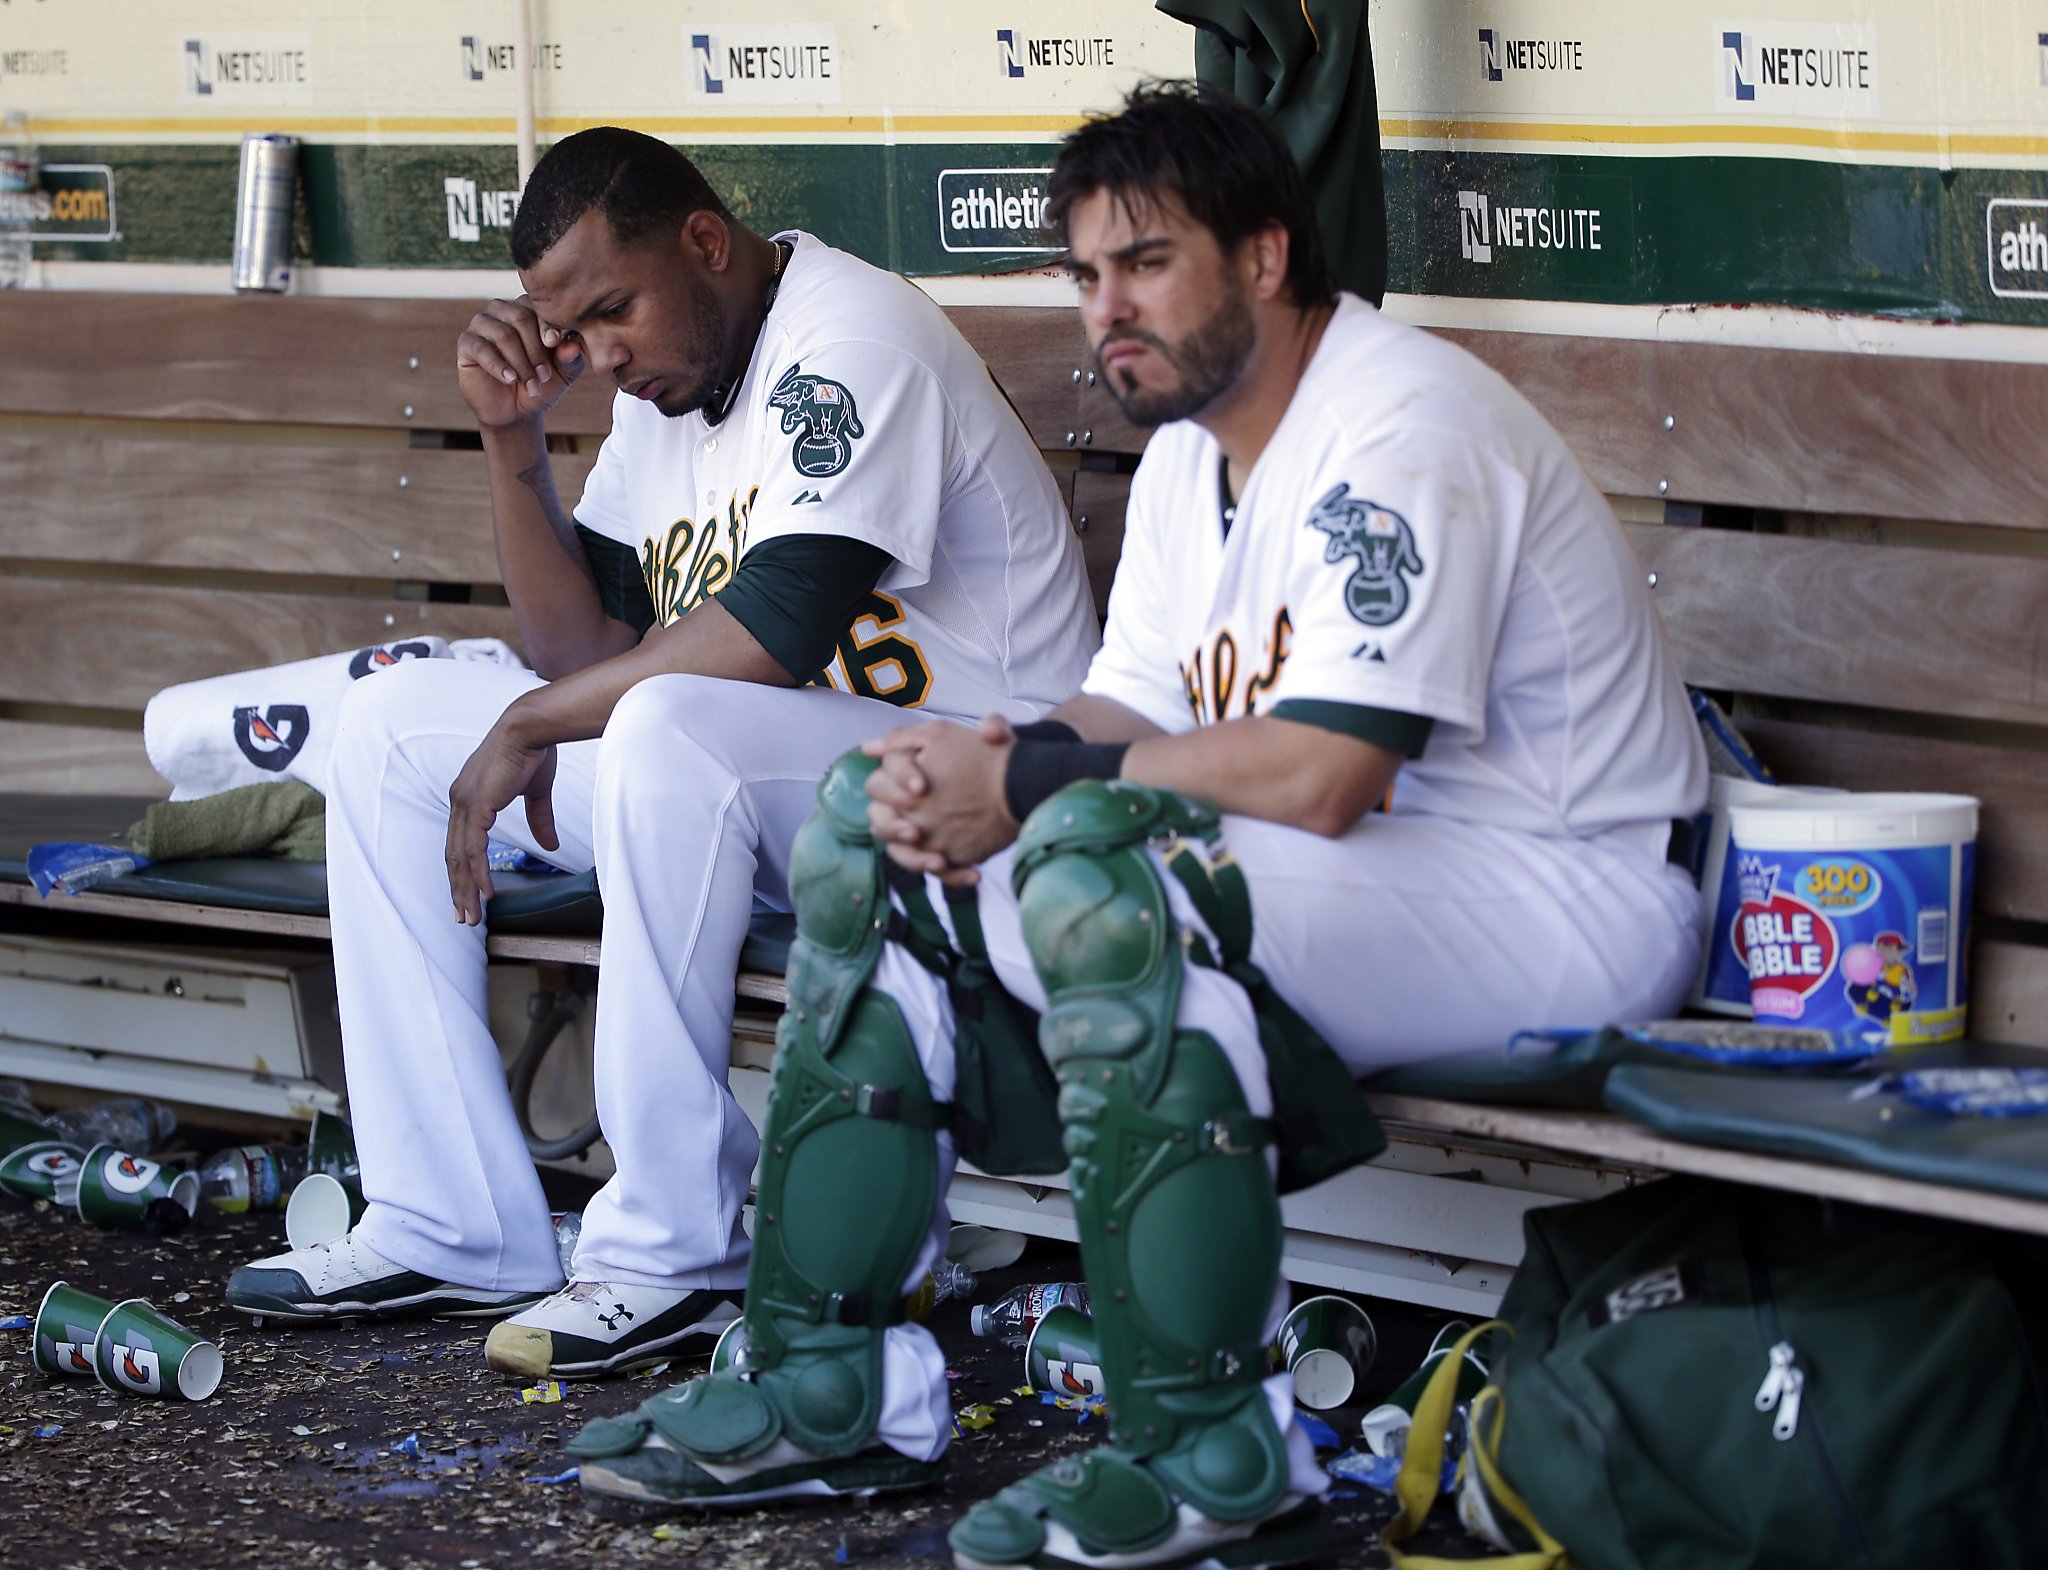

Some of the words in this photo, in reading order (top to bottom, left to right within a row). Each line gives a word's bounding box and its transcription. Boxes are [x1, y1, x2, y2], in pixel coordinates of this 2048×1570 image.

[217, 49, 306, 84] NETSUITE
[487, 45, 562, 69] NETITE
[729, 46, 831, 79] NETSUITE
[1029, 38, 1115, 67] NETSUITE
[1506, 40, 1583, 71] NETSUITE
[1761, 47, 1870, 90] NETSUITE
[1496, 206, 1602, 251] NETSUITE
[806, 588, 935, 710] 6
[1806, 864, 1870, 894] 300
